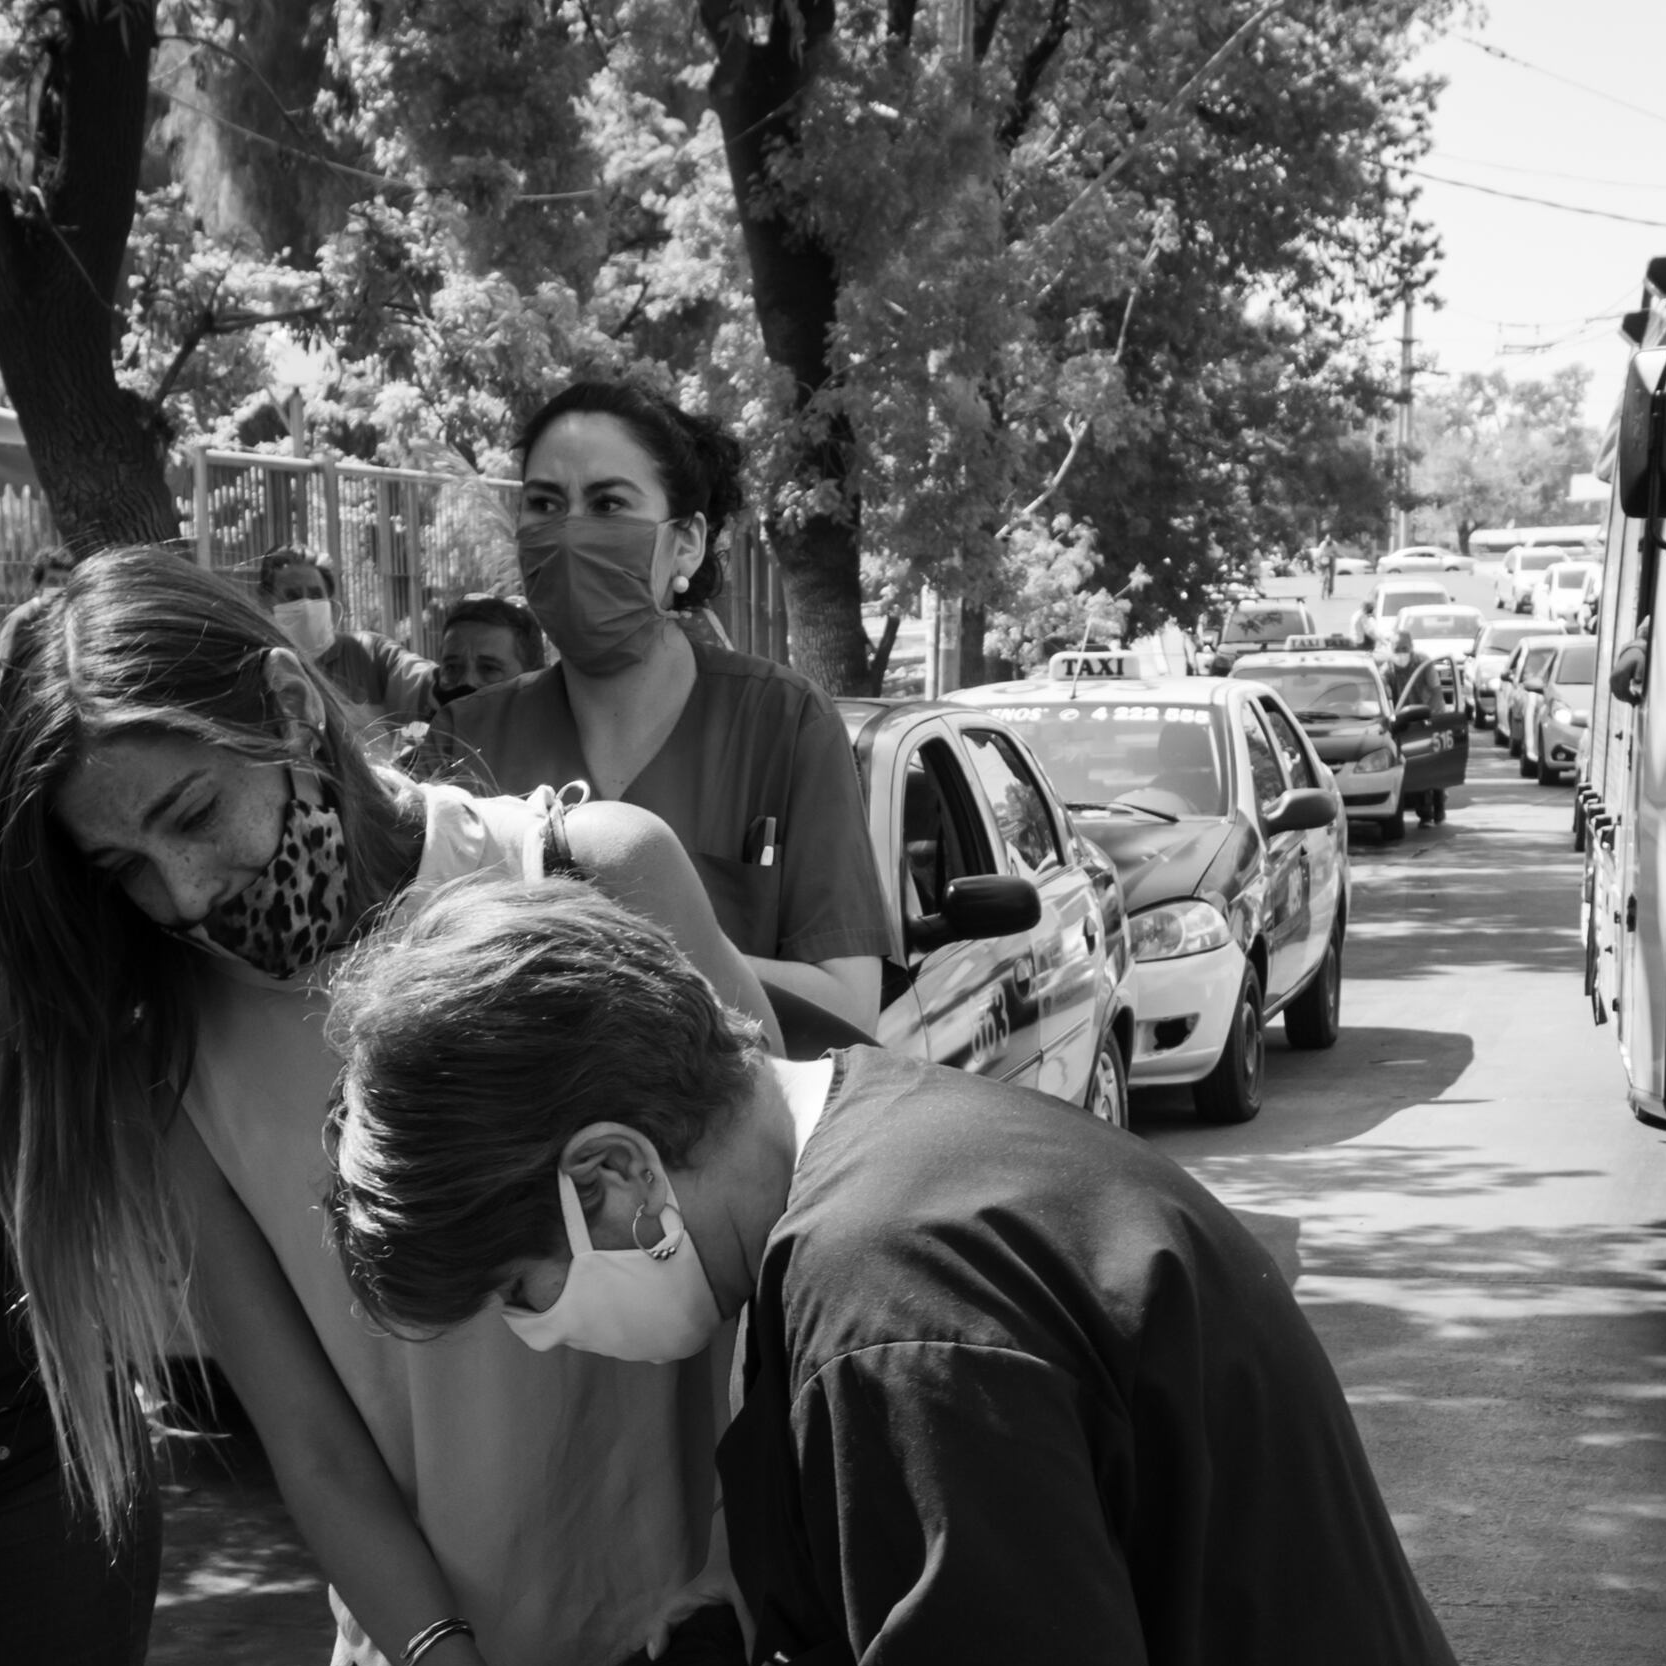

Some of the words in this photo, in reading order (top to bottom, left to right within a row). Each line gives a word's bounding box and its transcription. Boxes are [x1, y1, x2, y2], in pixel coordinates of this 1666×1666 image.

[1293, 638, 1320, 649] TAXI
[1060, 656, 1124, 676] TAXI
[1090, 706, 1108, 721] 4
[1113, 706, 1159, 721] 222
